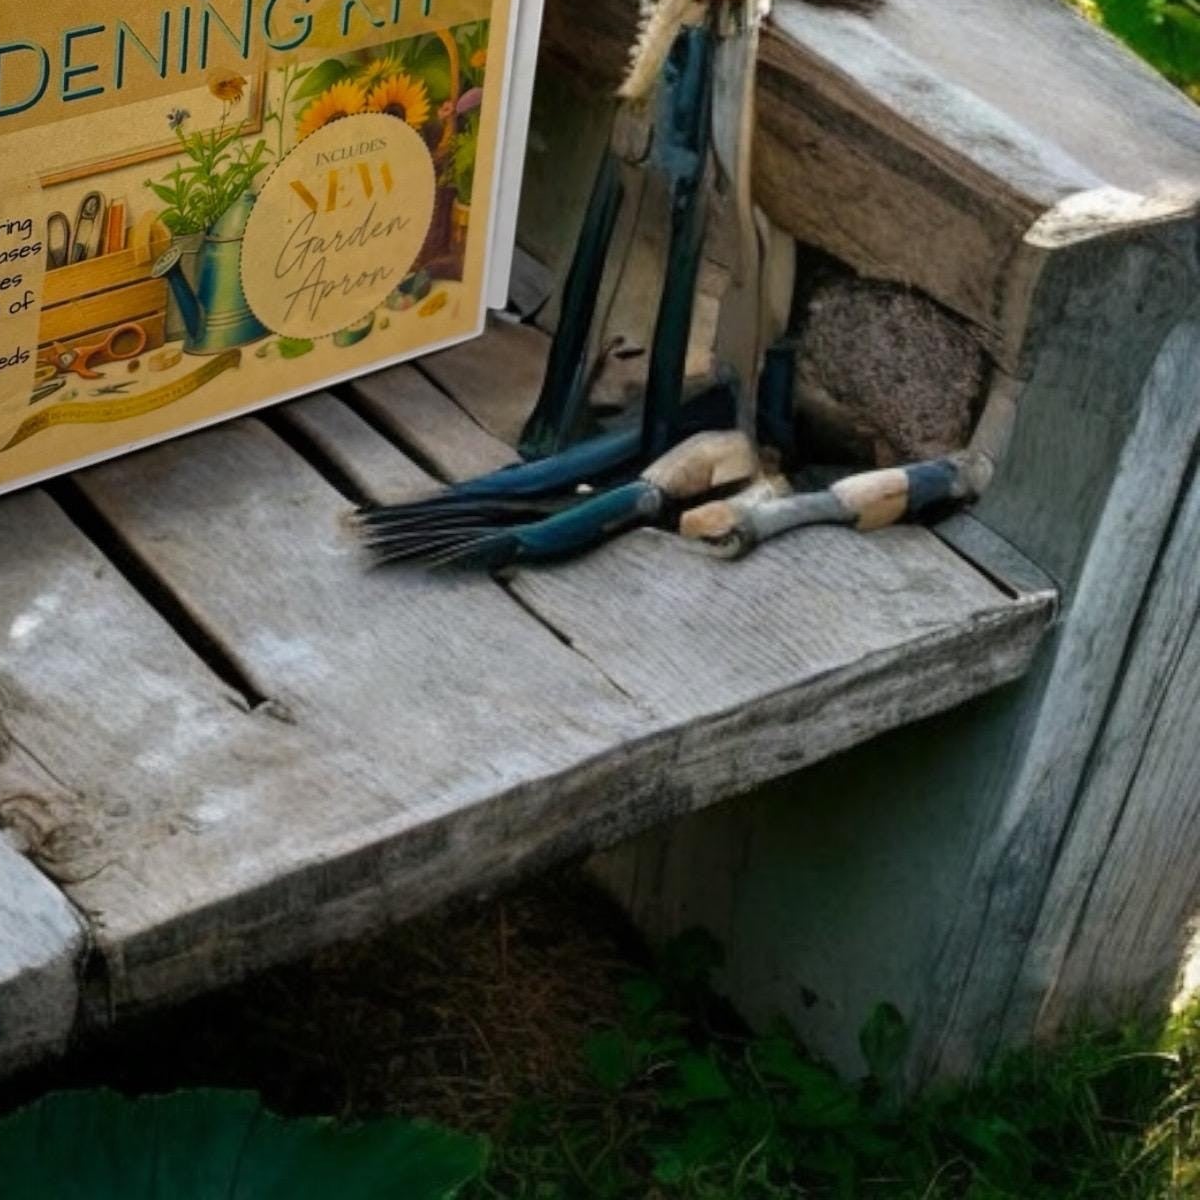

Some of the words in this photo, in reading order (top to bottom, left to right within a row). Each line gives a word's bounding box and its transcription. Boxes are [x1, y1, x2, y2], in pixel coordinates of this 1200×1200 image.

[315, 139, 388, 166] INCLUDES
[289, 161, 393, 221] NEW
[275, 203, 409, 279] Garden
[9, 291, 35, 314] of
[283, 256, 393, 322] Apron
